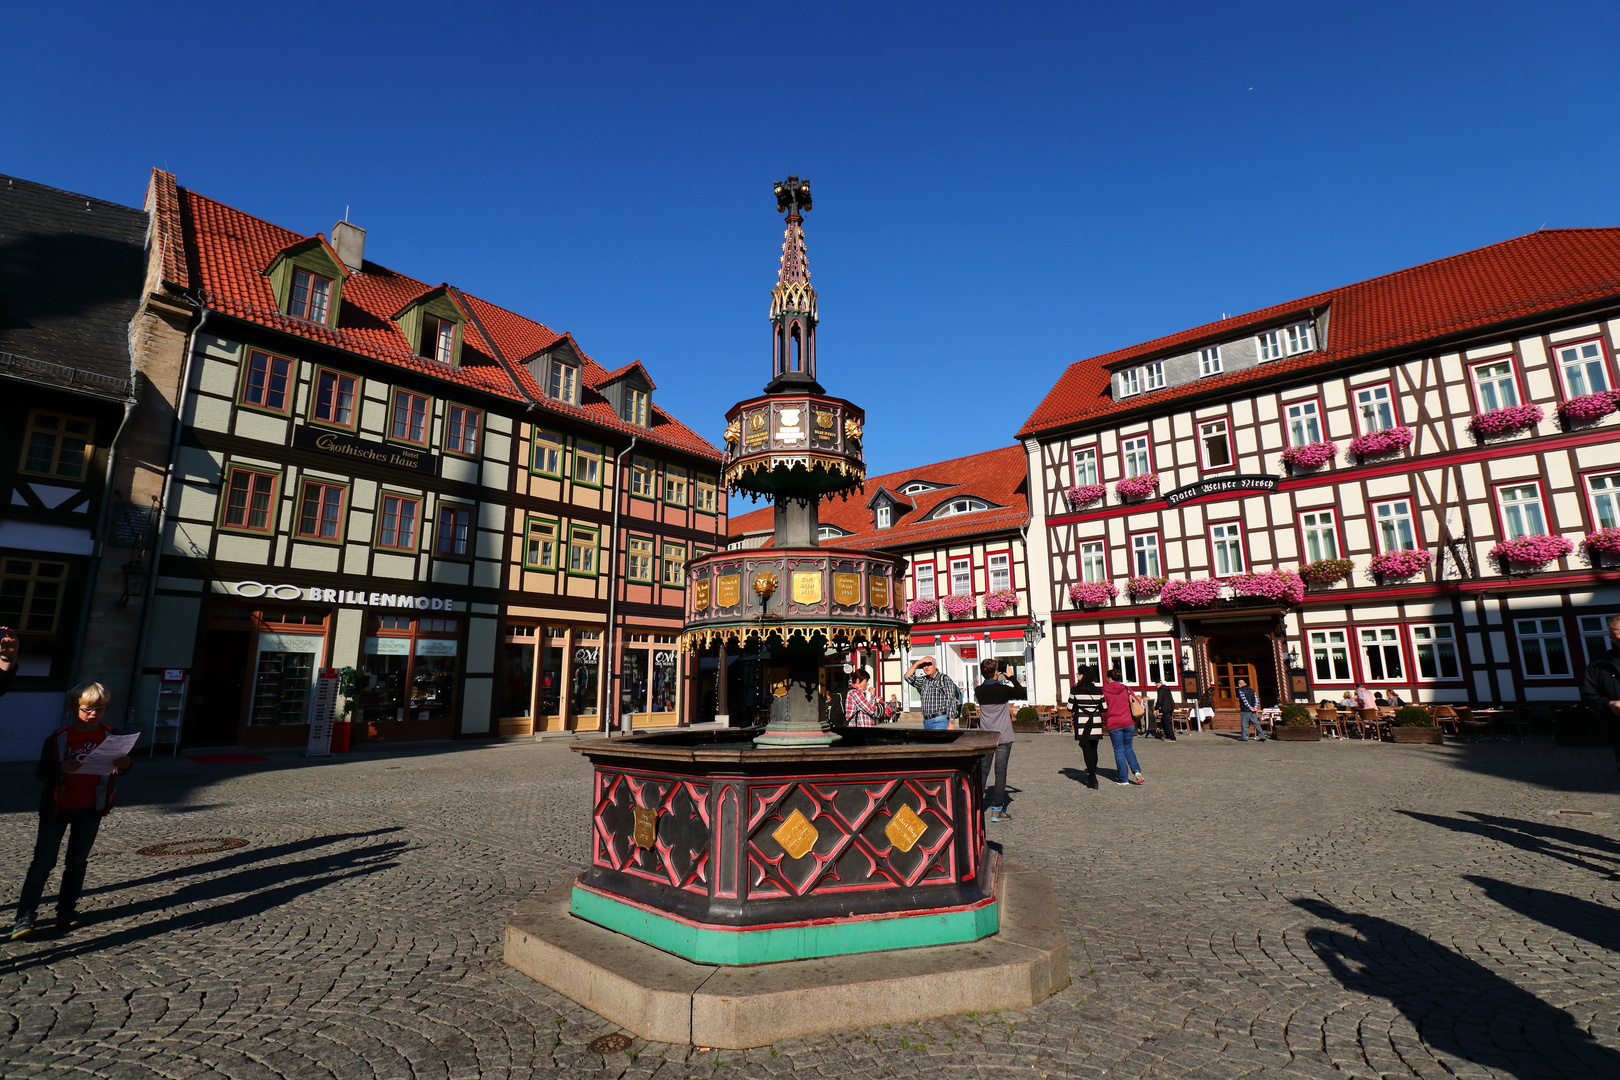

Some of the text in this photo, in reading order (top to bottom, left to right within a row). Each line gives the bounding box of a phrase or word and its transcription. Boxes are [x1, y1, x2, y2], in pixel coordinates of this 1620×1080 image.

[315, 433, 418, 469] Gothisches Haus
[402, 450, 419, 459] Hotel
[1241, 479, 1274, 489] Hirsch
[310, 587, 453, 611] BRILLENMODE
